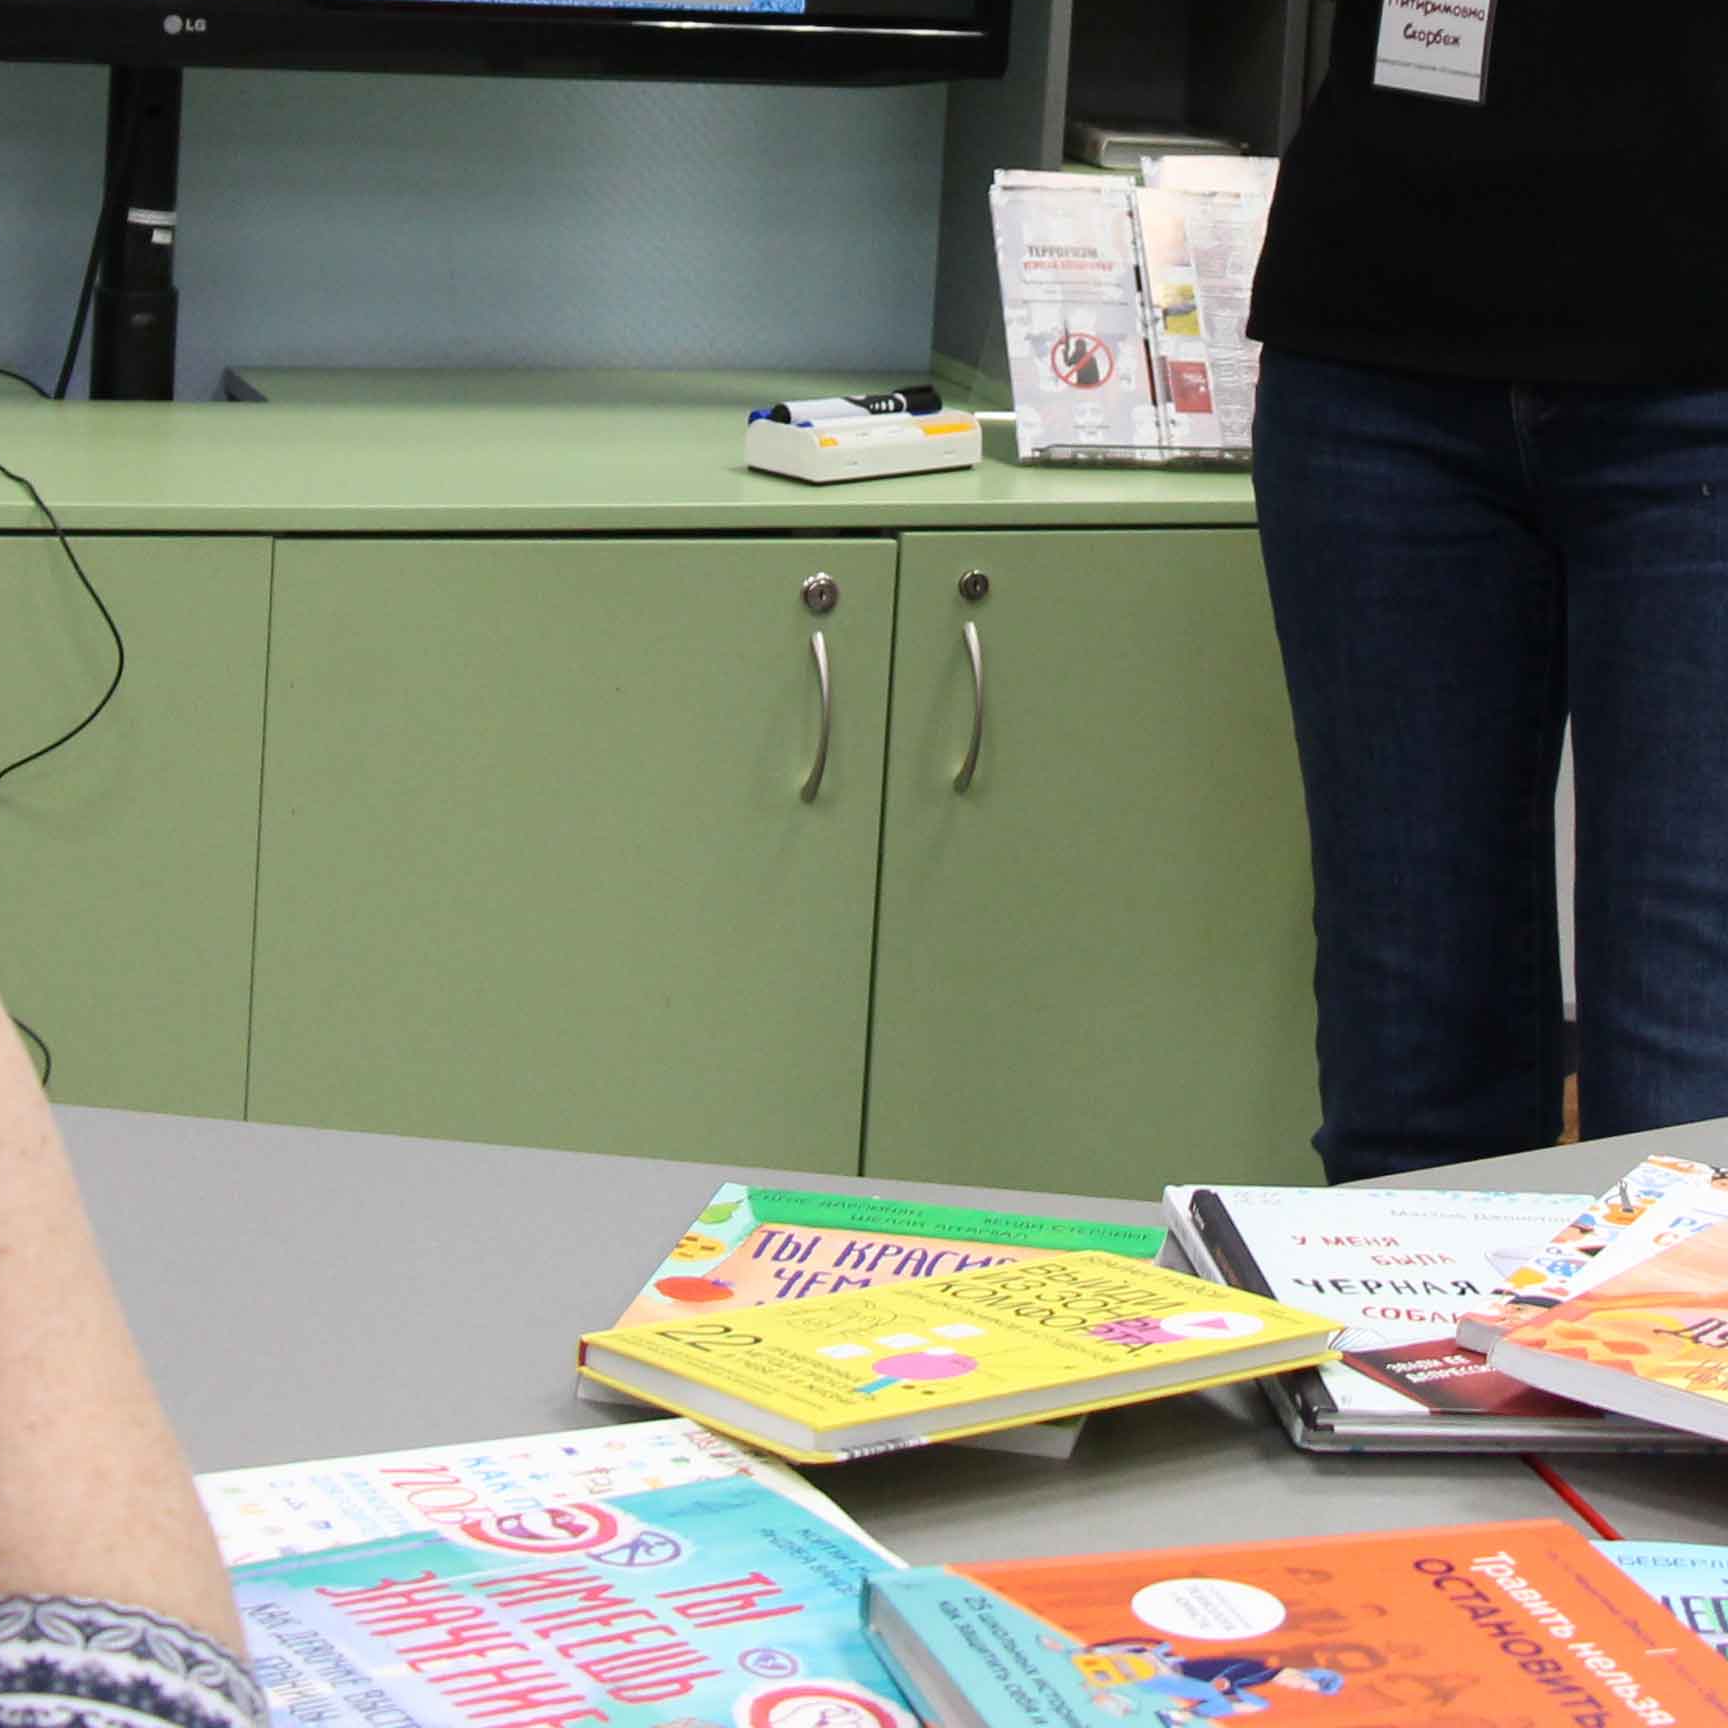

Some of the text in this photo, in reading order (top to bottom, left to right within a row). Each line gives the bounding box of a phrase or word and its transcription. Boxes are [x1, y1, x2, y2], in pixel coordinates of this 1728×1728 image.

[185, 18, 207, 33] LG
[750, 1229, 1018, 1278] ТЫ КРАСИ
[1319, 1234, 1401, 1249] МЕНЯ
[1371, 1252, 1458, 1267] БЫЛА
[1292, 1276, 1482, 1298] ЧЕРНАЯ
[657, 1322, 763, 1353] 22
[655, 1571, 806, 1630] ТЫ
[472, 1564, 723, 1705] ИМЕЕШЬ
[1412, 1556, 1611, 1728] ОСТАНОВИТЬ
[1472, 1550, 1577, 1640] Травить
[1569, 1641, 1676, 1728] нельзя
